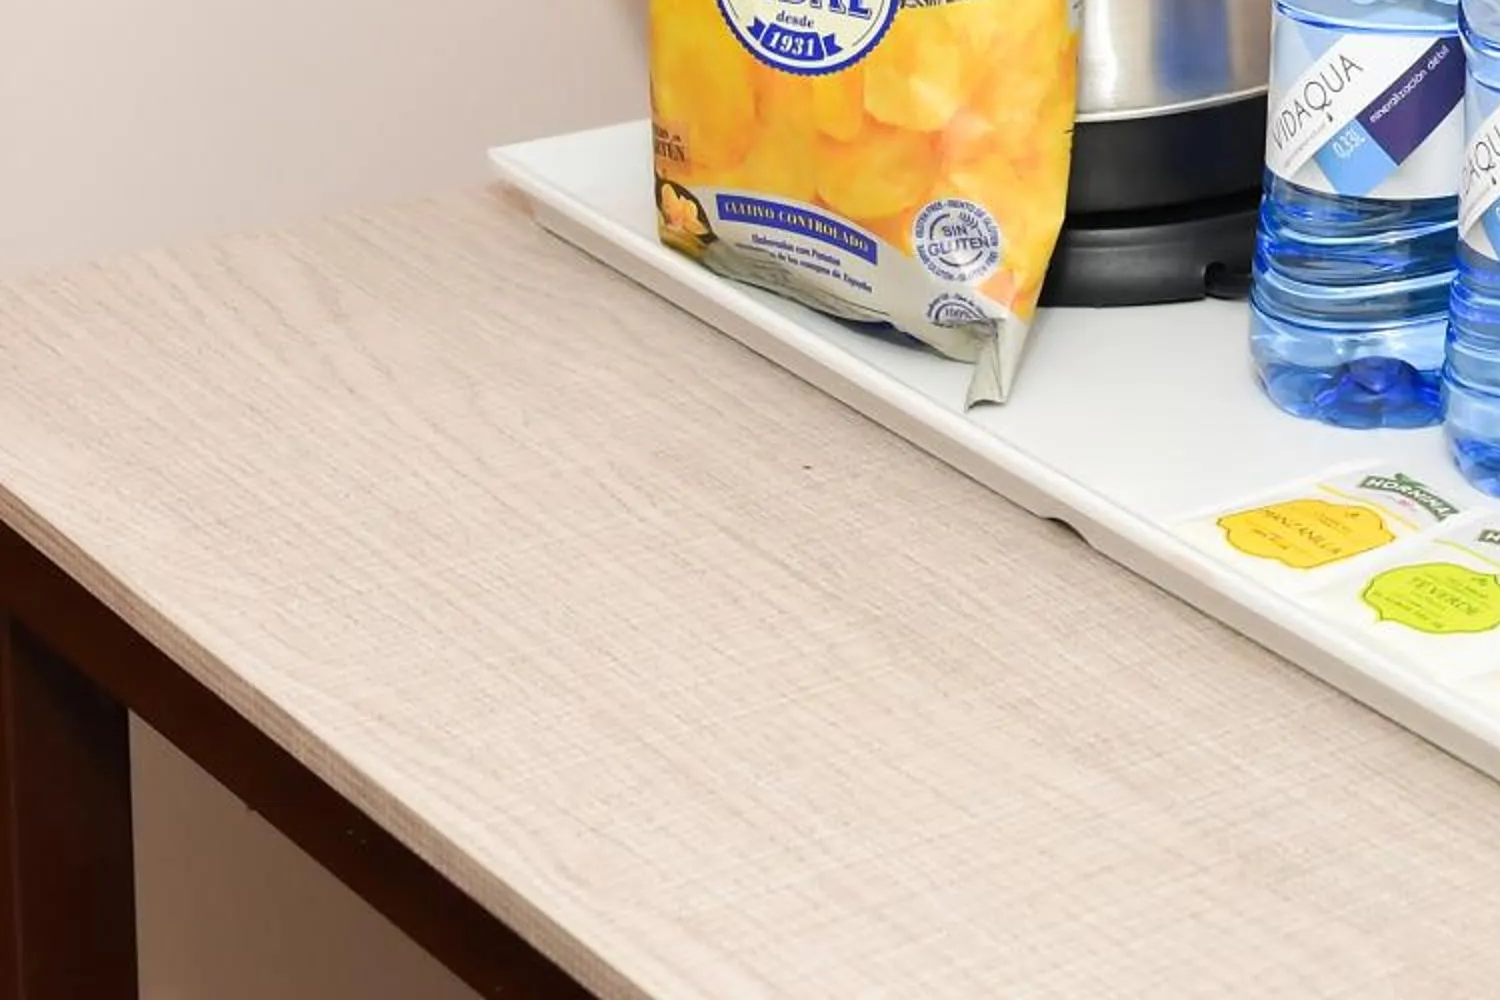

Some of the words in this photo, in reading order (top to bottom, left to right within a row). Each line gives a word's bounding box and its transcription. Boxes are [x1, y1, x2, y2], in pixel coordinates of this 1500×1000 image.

[775, 10, 815, 28] desde
[769, 31, 815, 57] 1931
[1272, 53, 1364, 150] VIDAQUA
[778, 212, 869, 252] CONTROLADO
[941, 224, 968, 238] SIN
[927, 236, 990, 257] GLUTEN
